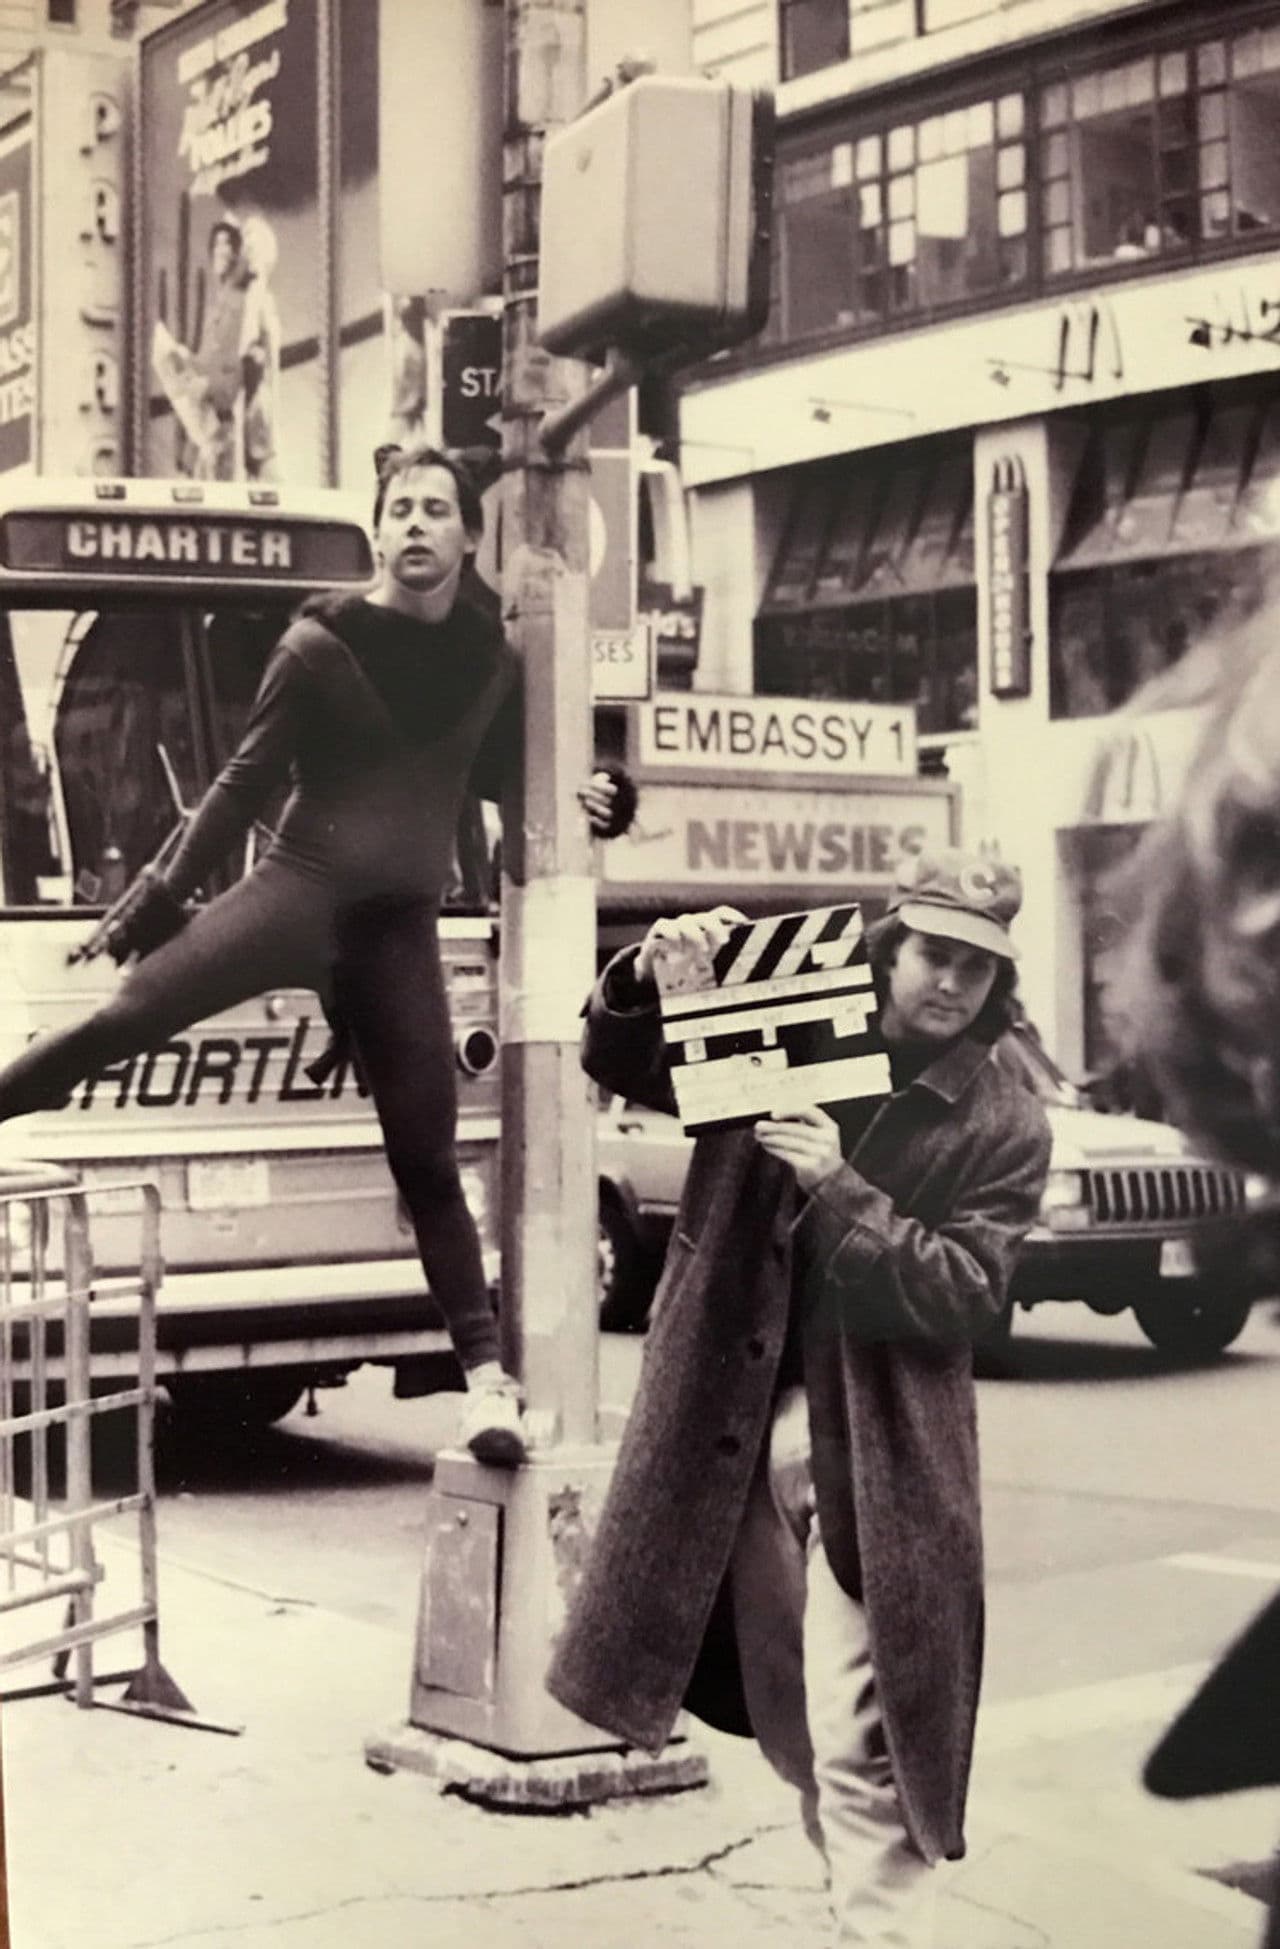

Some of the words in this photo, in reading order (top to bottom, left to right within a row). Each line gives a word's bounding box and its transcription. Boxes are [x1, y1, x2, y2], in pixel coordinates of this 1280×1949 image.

[67, 521, 292, 568] CHARTER
[593, 640, 633, 663] SES
[653, 706, 873, 762] EMBASSY
[889, 721, 904, 761] 1
[685, 819, 927, 874] NEWSIES
